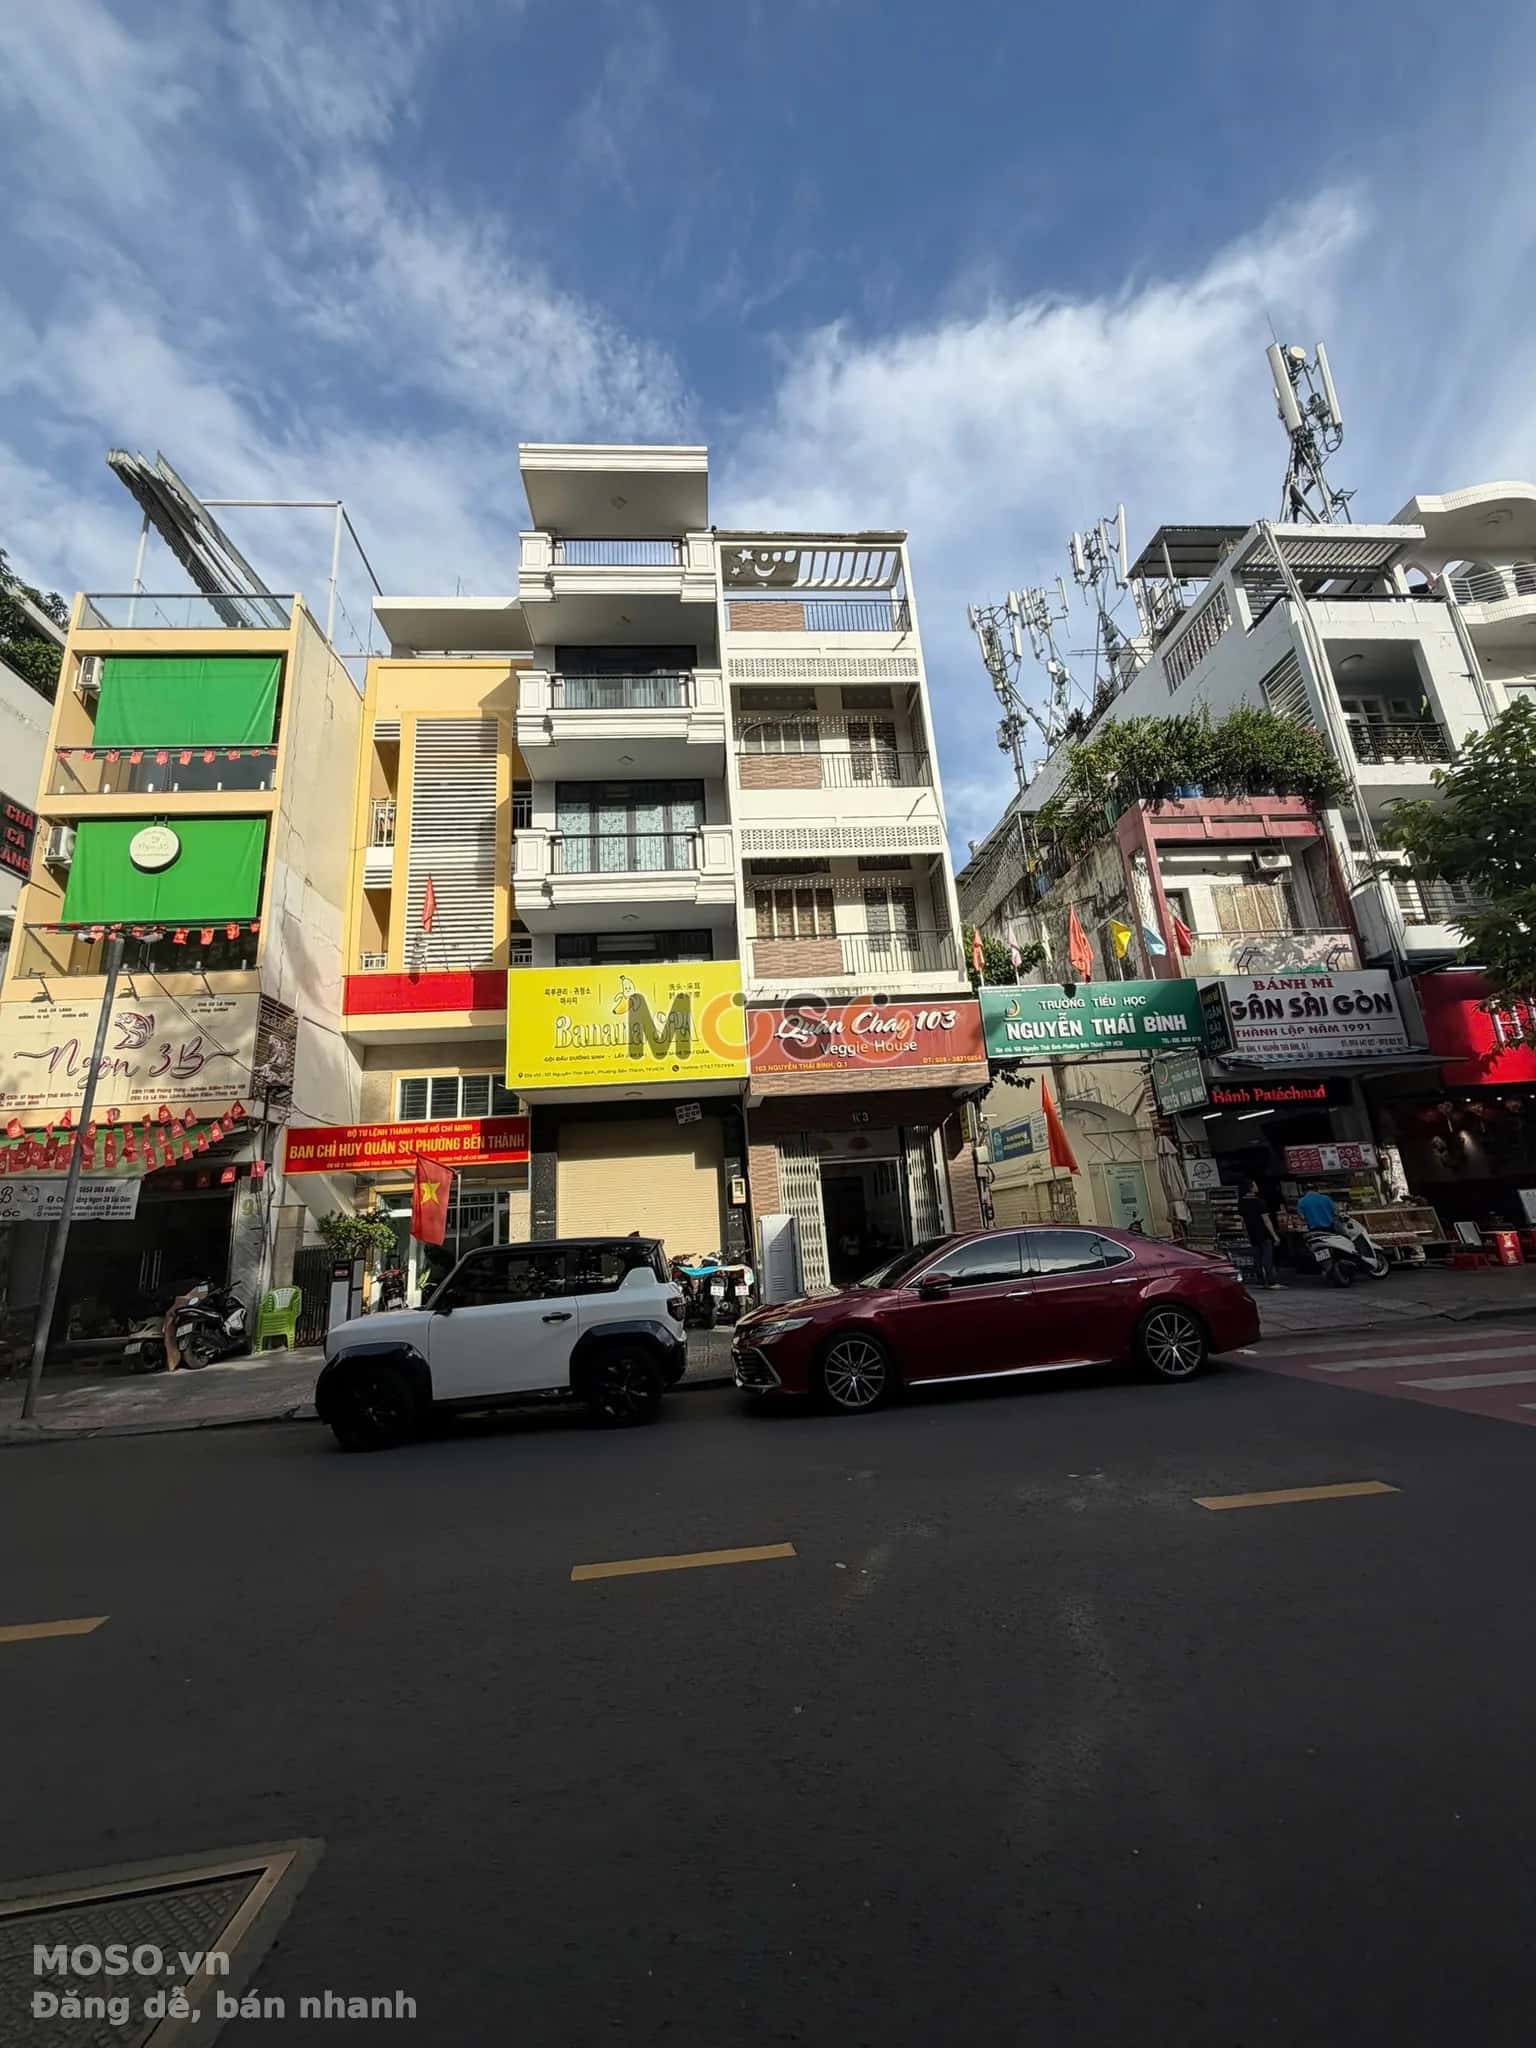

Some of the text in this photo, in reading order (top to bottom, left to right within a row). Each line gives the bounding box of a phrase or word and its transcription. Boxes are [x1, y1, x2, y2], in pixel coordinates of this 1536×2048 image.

[1252, 974, 1334, 991] BÁNH MÌ
[1092, 993, 1116, 1008] TIỂU
[1124, 995, 1147, 1007] HỌC
[1289, 991, 1329, 1018] SÀI
[1333, 989, 1393, 1015] GÒN
[554, 1016, 645, 1049] Banana
[774, 1009, 957, 1042] Quán Chay 103
[1006, 1012, 1083, 1040] NGUYỄN
[1143, 1010, 1188, 1033] BÌNH
[1233, 1022, 1372, 1037] THÀNH LẬP NĂM 1991
[821, 1039, 917, 1057] Veggie House
[1212, 1085, 1250, 1104] Bánh
[289, 1132, 525, 1159] BAN CHỈ HUY QUÂN SỰ PHƯỜNG BẾN THÀNH
